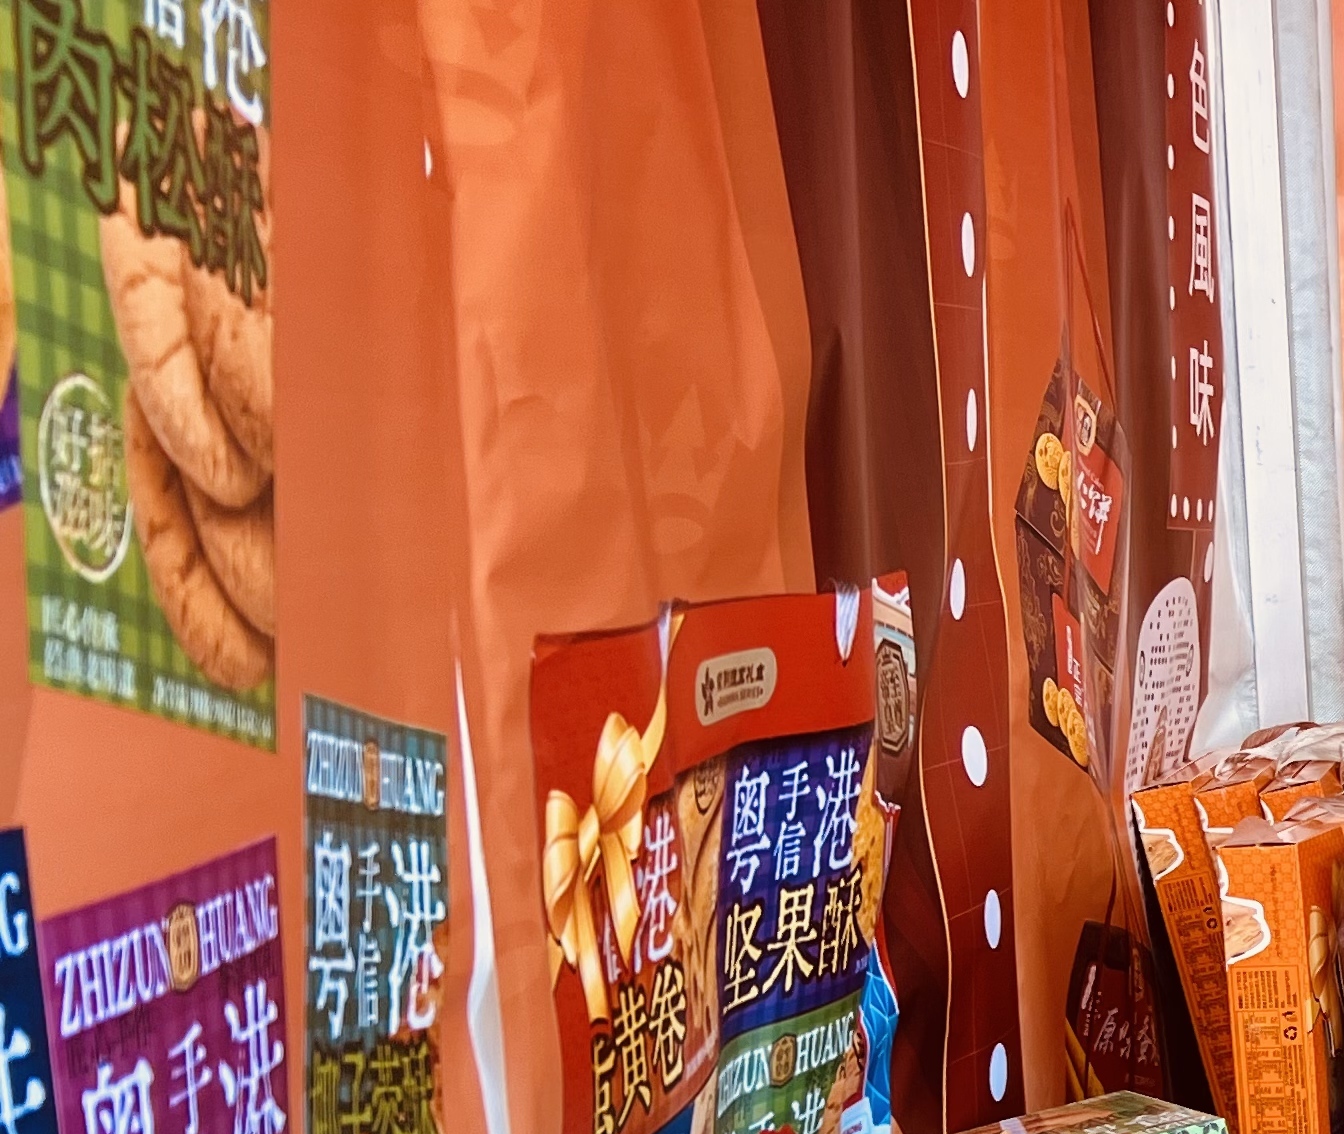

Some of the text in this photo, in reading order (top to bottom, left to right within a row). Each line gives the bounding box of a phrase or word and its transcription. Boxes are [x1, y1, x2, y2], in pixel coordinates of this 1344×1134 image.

[55, 875, 278, 1037] ZHIZUN HUANG
[792, 1010, 855, 1075] HUANG
